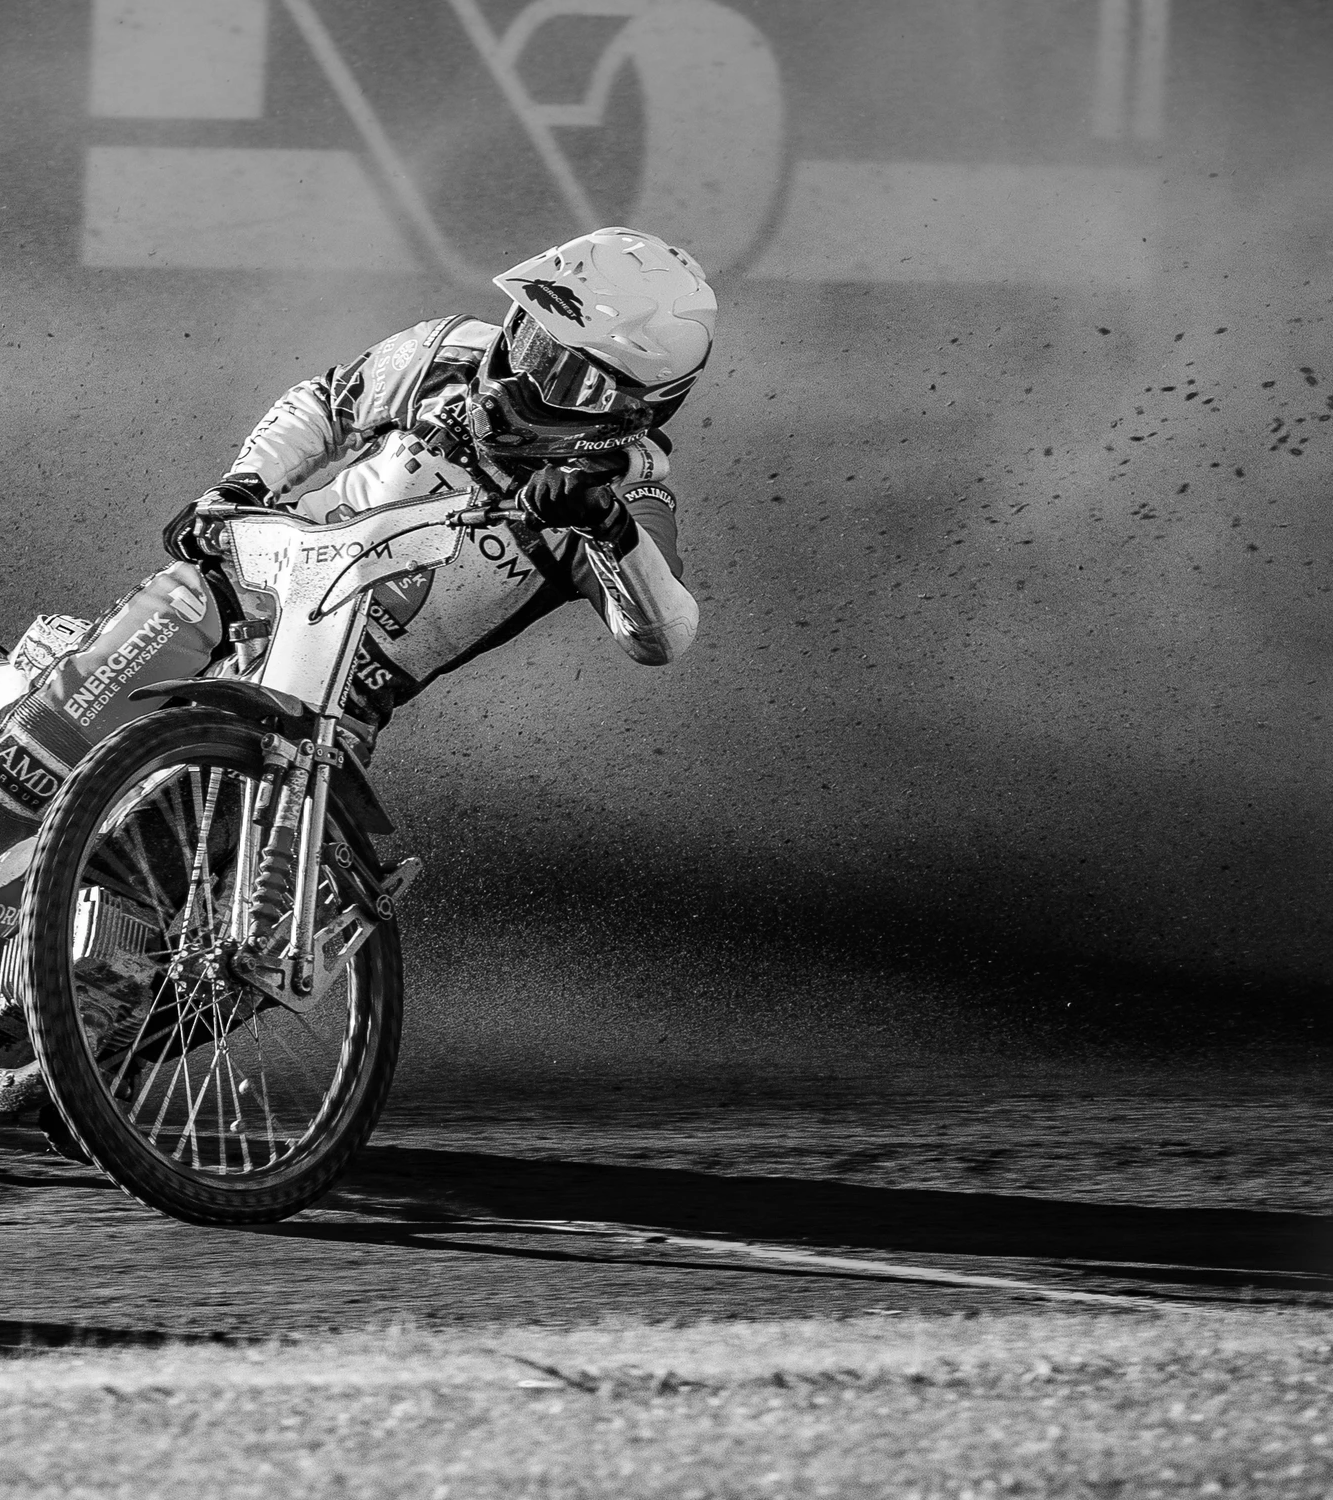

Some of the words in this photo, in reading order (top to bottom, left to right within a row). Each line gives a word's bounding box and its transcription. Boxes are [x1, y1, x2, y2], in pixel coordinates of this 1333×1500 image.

[537, 283, 577, 319] AGROCHEST
[372, 355, 391, 414] Sushi
[301, 540, 394, 564] TEXOM
[63, 611, 171, 720] ENERGETYK
[79, 682, 121, 727] OSIEDLE
[118, 621, 180, 684] PRZYSZŁOŚĆ
